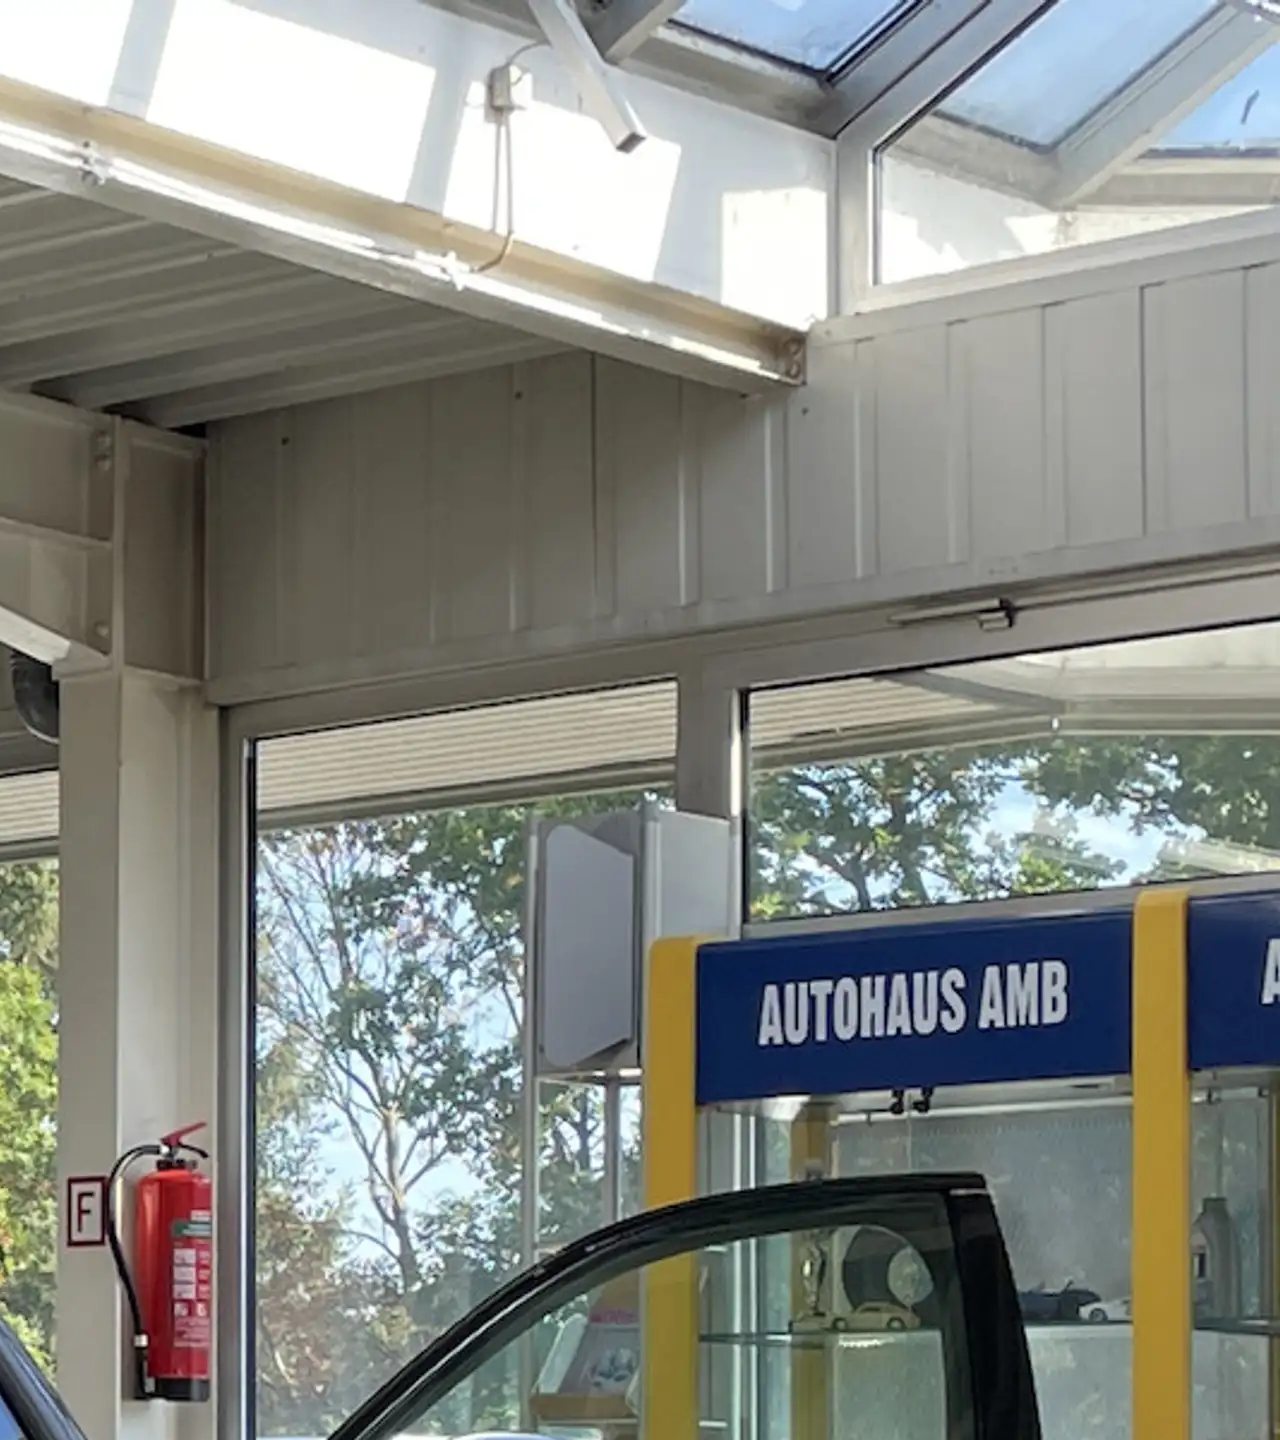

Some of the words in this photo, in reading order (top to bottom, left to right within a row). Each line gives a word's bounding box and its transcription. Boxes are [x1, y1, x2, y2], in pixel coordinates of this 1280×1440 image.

[758, 967, 968, 1047] AUTOHAUS
[978, 959, 1070, 1030] AMB
[77, 1192, 94, 1232] F
